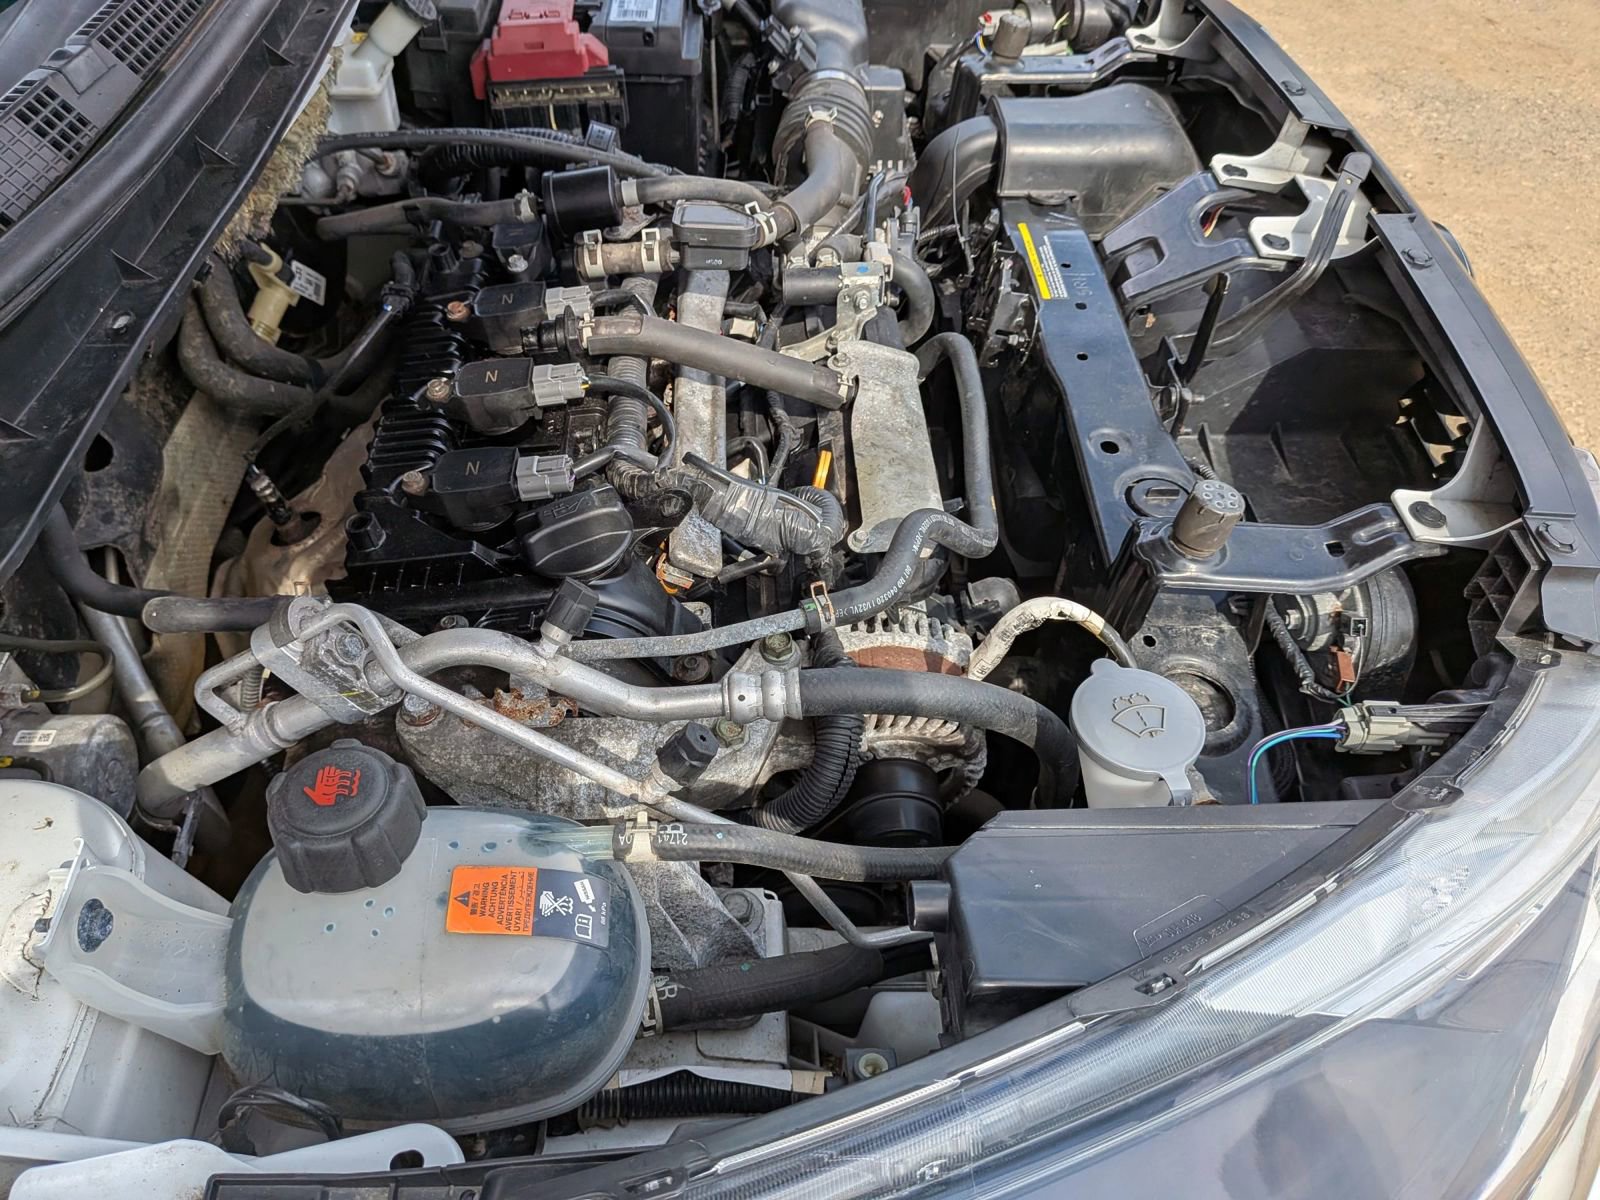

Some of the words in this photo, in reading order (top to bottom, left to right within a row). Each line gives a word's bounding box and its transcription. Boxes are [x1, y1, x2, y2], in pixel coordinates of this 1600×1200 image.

[501, 293, 514, 305] N
[484, 369, 499, 383] N
[464, 460, 481, 476] N
[479, 881, 490, 917] WARNING
[487, 881, 499, 918] ACHTUNG
[505, 870, 517, 931] AVERTISSEMENT
[523, 871, 535, 932] ПРЕДУПРЕЖДЕНИЕ
[513, 907, 521, 932] UYARI
